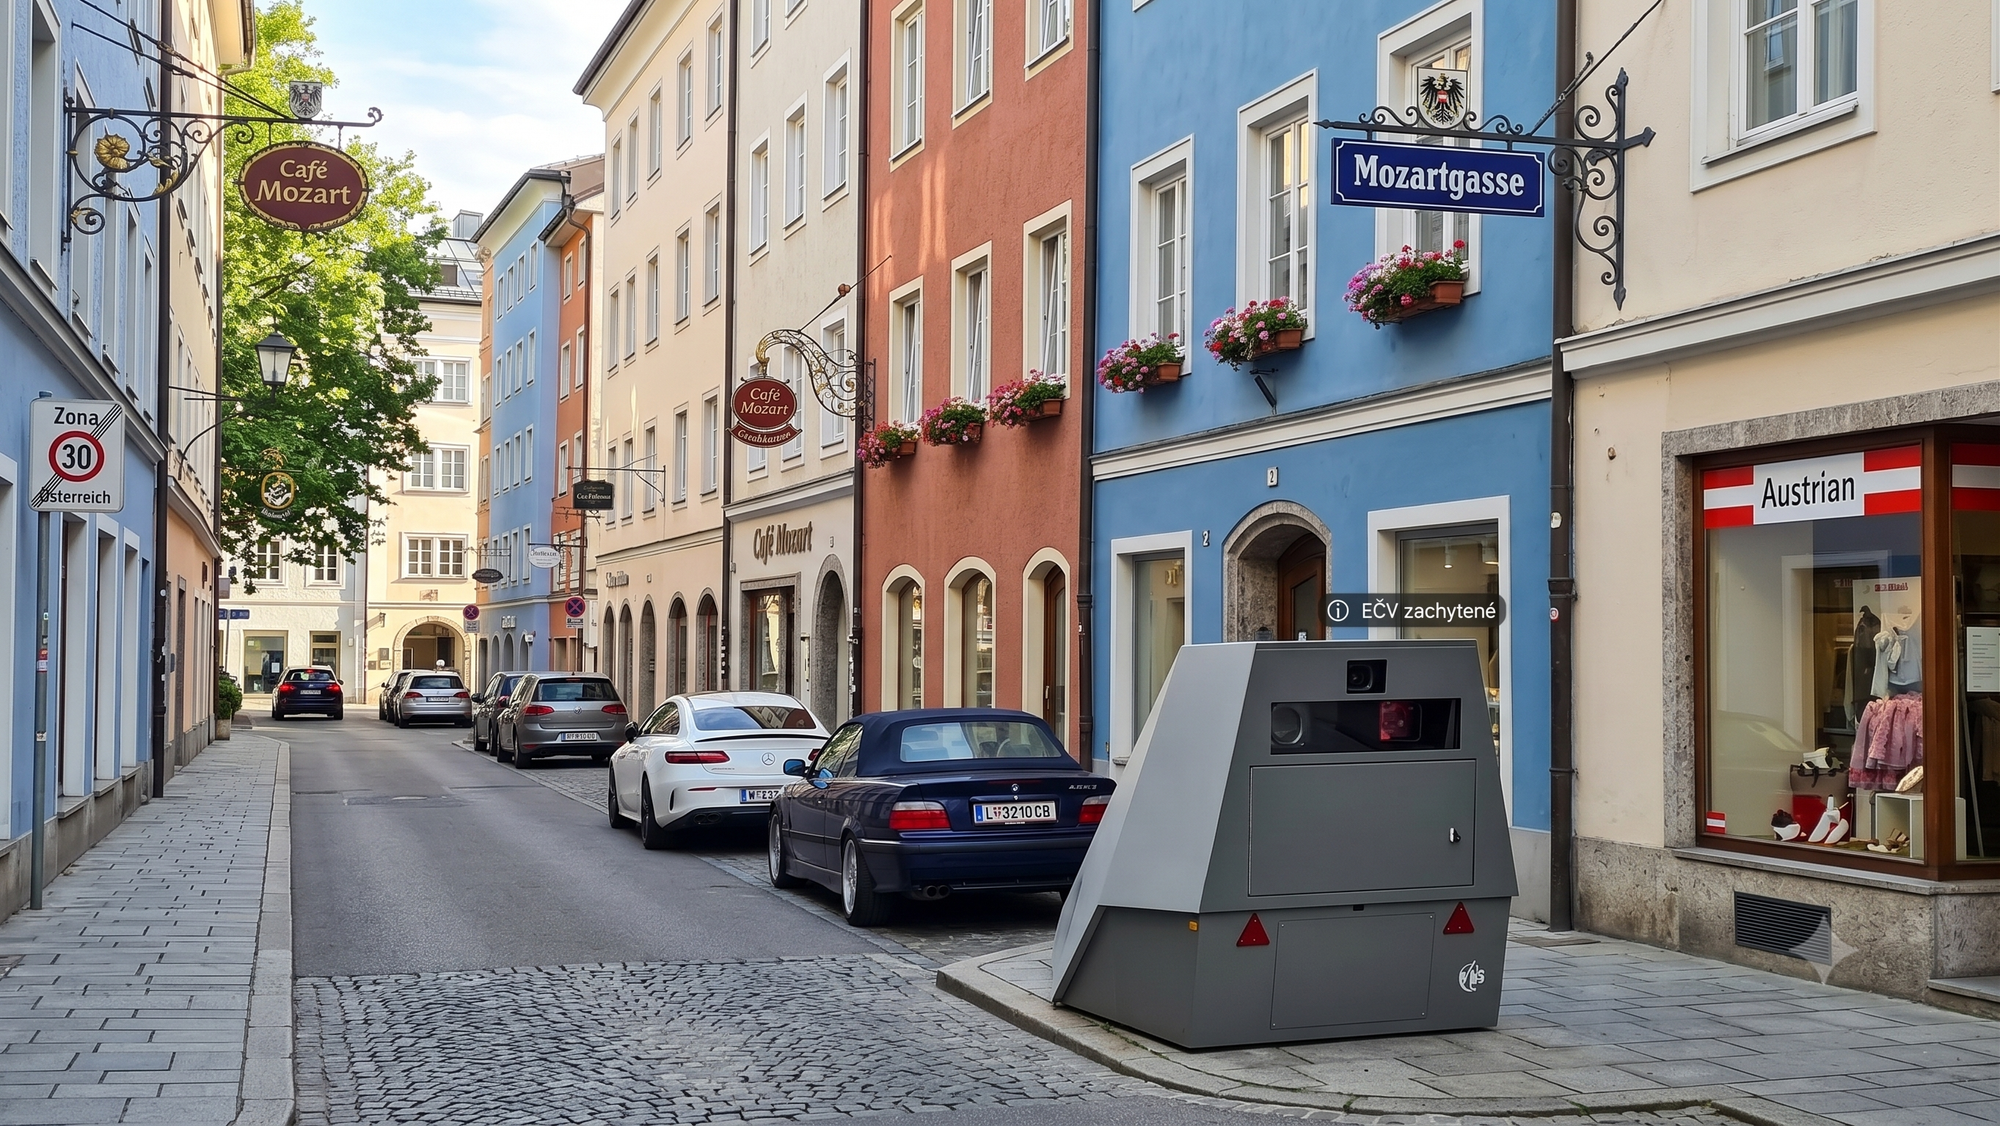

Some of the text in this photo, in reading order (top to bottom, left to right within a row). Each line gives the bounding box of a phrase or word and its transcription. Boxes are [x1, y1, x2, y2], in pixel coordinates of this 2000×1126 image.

[280, 159, 328, 183] Café
[1354, 153, 1525, 201] Mozartgasse
[254, 179, 351, 205] Mozart
[740, 401, 789, 415] Mozart
[750, 387, 781, 404] Café
[53, 406, 99, 426] Zona
[61, 443, 92, 470] 30
[1761, 470, 1855, 508] Austrian
[753, 521, 813, 566] Café Mozart
[1202, 530, 1210, 547] 2
